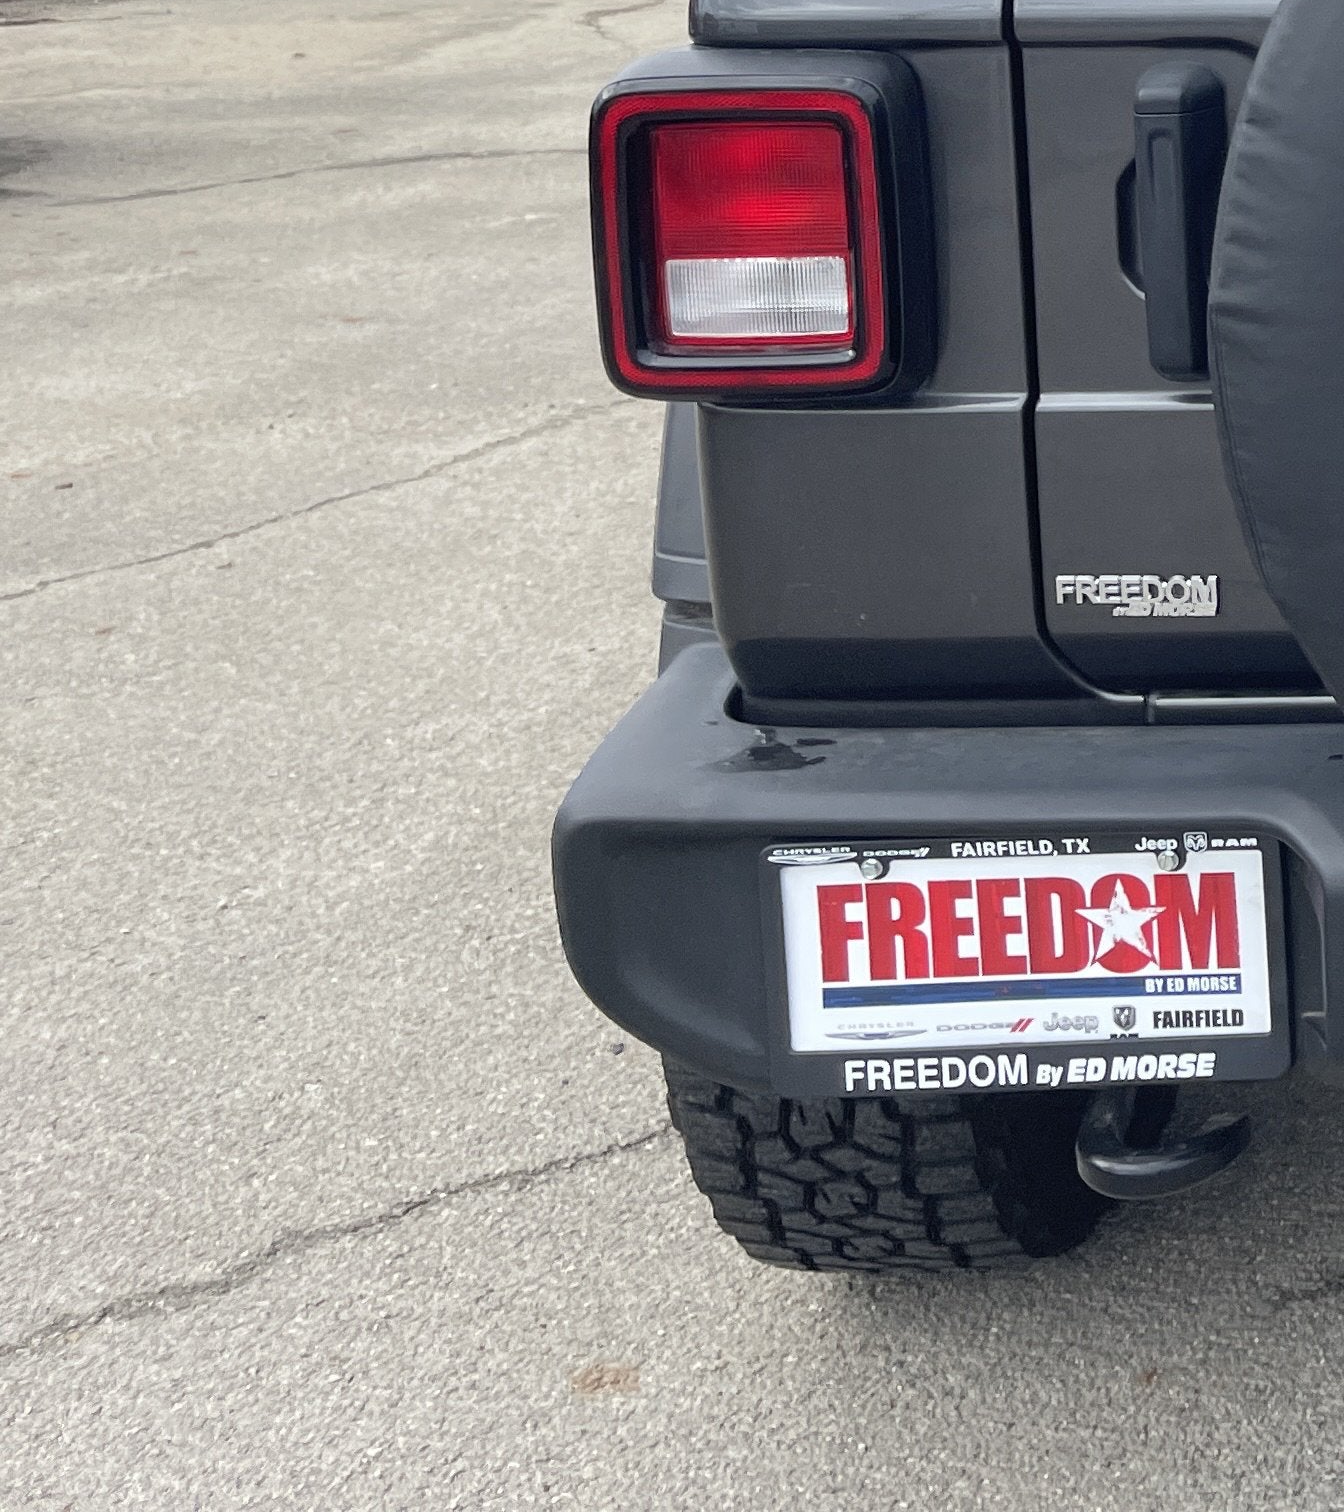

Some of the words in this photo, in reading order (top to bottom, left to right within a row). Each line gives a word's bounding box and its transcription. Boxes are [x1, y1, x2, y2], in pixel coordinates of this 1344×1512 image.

[1055, 574, 1218, 605] FREEDOM
[1061, 837, 1091, 854] TX
[1134, 837, 1178, 852] Jeep
[1211, 837, 1258, 848] RAM
[816, 872, 1241, 982] FREEDOM
[1145, 978, 1164, 993] BY
[1166, 977, 1183, 992] ED
[1187, 975, 1237, 992] MORSE
[837, 1021, 915, 1030] CHRYSLER
[1043, 1012, 1100, 1034] Jeep
[1153, 1009, 1244, 1029] FAIRFIELD
[844, 1054, 1028, 1092] FREEDOM
[1035, 1064, 1064, 1087] By
[1066, 1057, 1107, 1083] ED
[1110, 1052, 1216, 1081] MORSE
